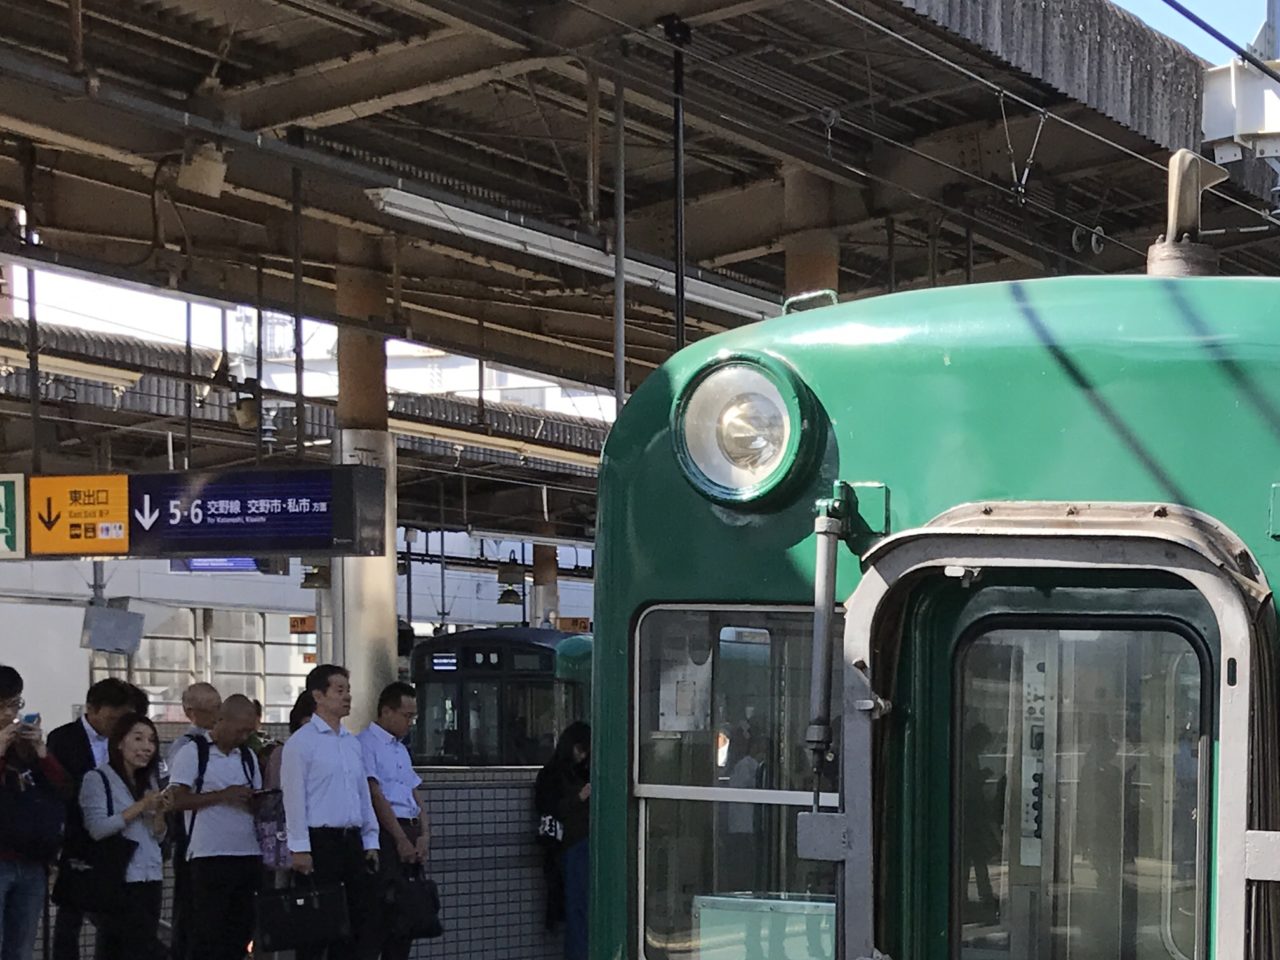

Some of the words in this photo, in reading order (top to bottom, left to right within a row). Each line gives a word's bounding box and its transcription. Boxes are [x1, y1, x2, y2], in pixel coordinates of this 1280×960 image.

[69, 489, 109, 506] 東出口
[207, 500, 241, 515] 交野線
